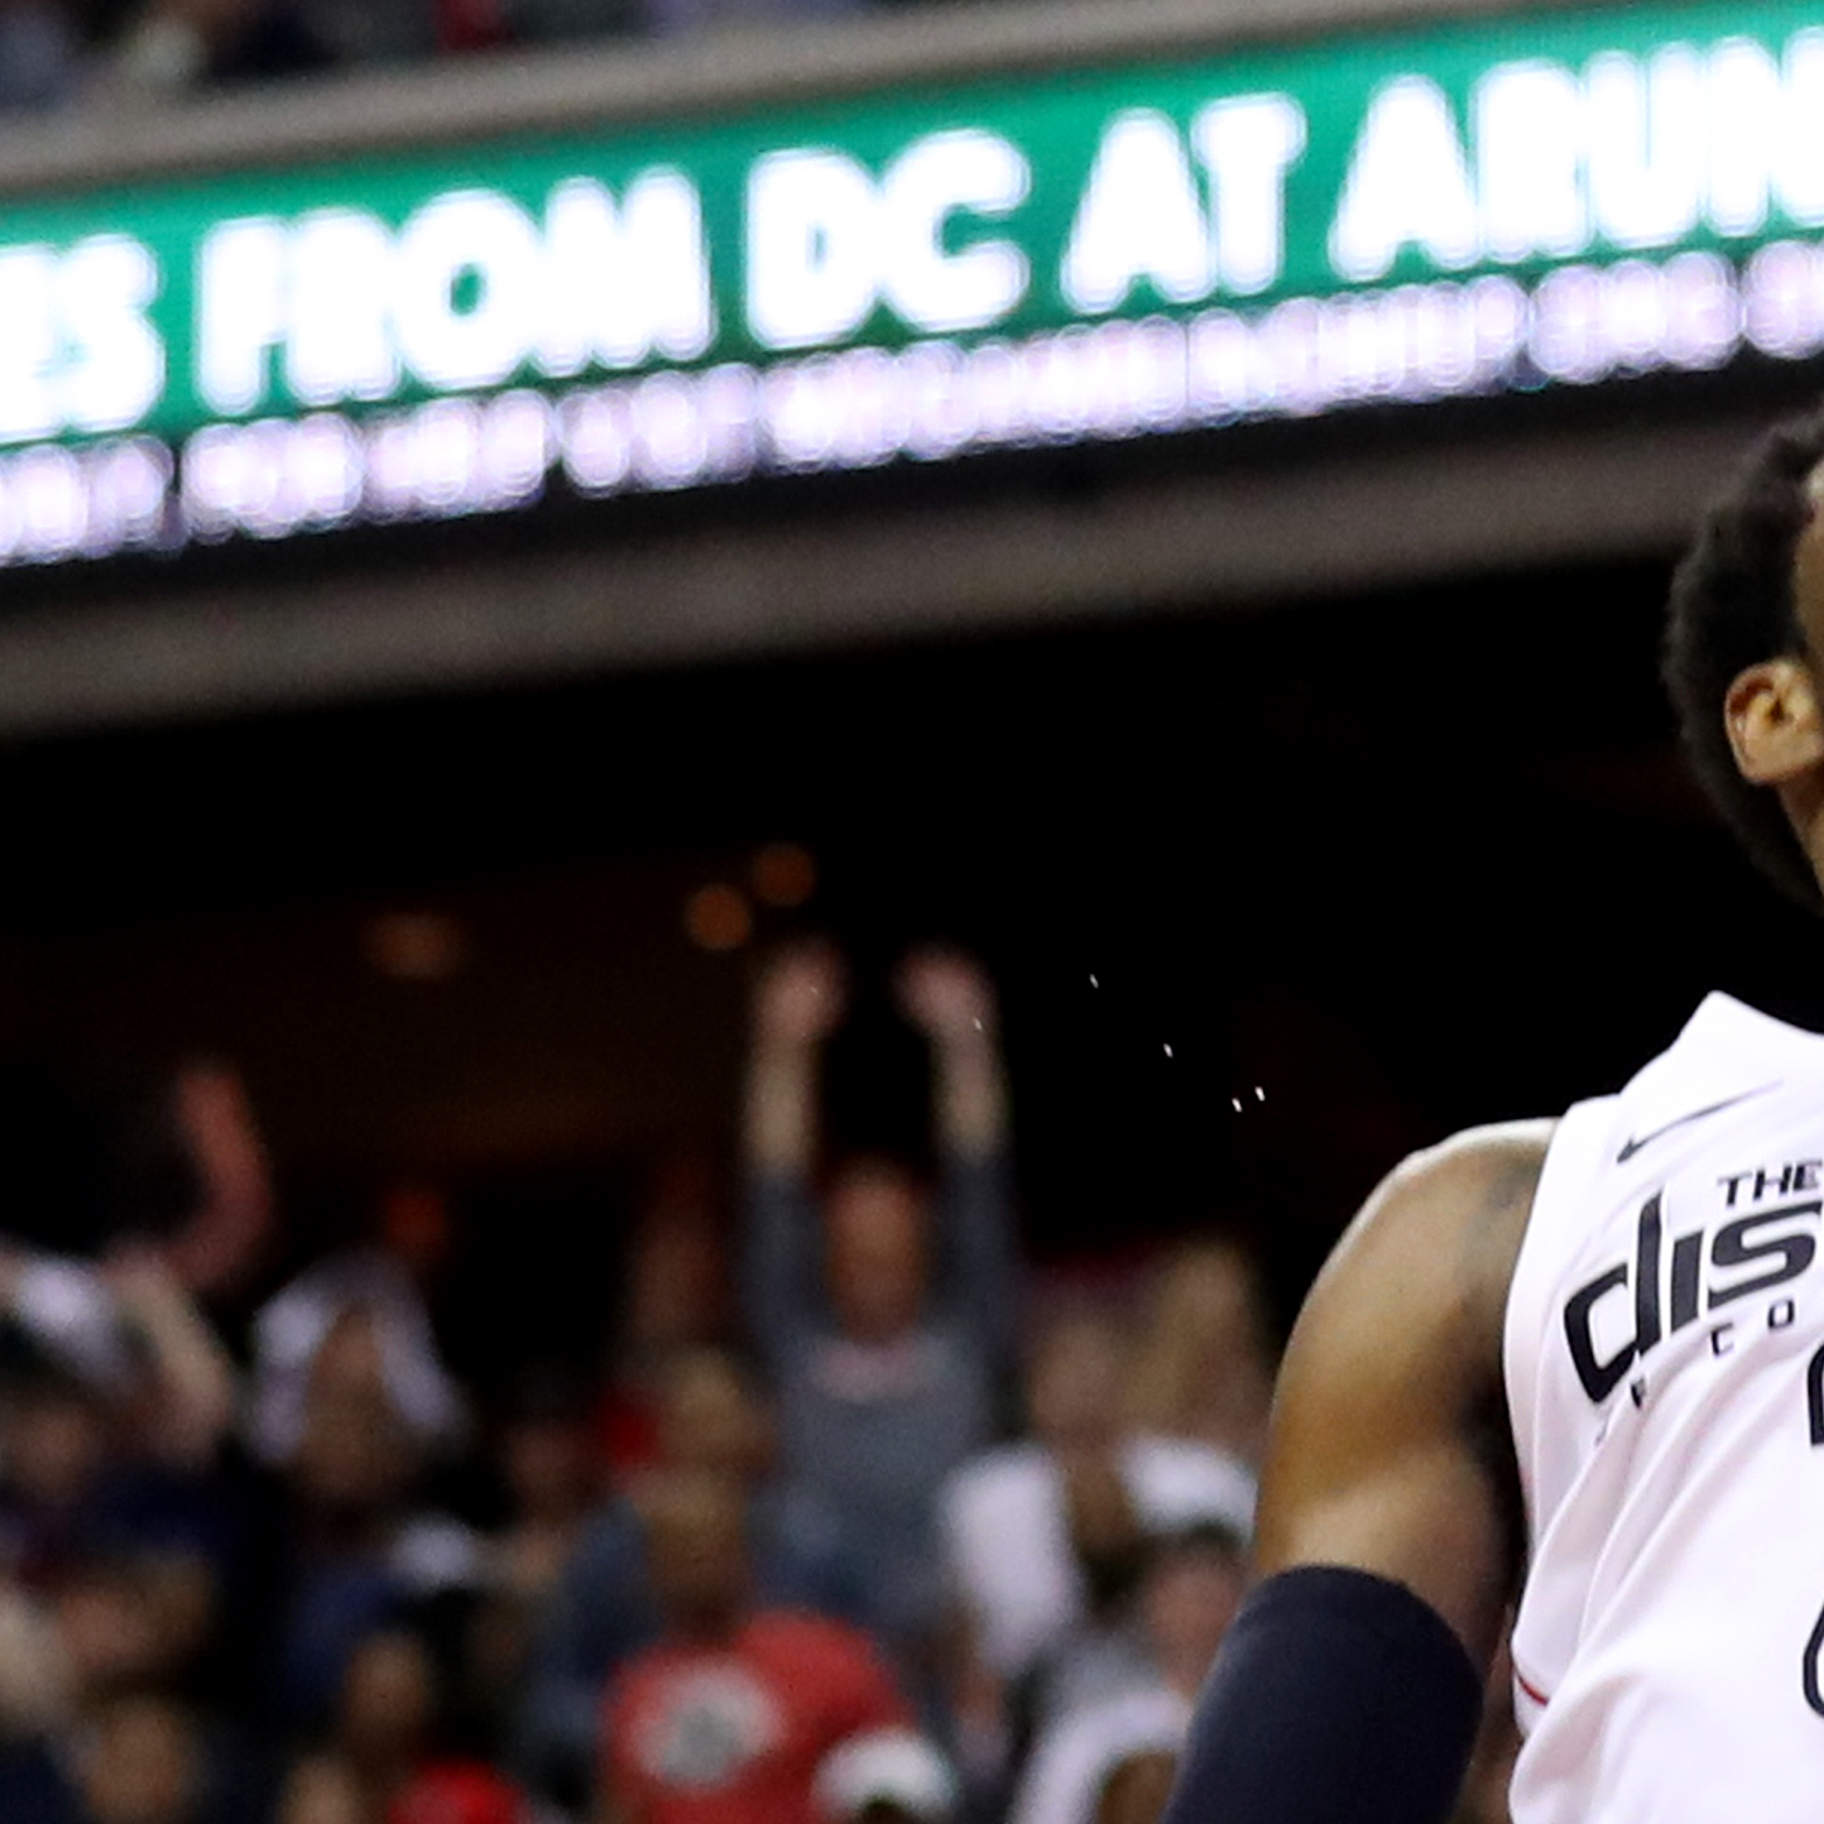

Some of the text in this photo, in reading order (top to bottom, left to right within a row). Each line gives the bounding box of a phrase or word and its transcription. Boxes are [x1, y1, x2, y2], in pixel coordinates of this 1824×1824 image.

[195, 164, 718, 416] FROM
[744, 126, 1034, 351] DC
[1058, 91, 1310, 314] AT
[1719, 1161, 1823, 1208] THE
